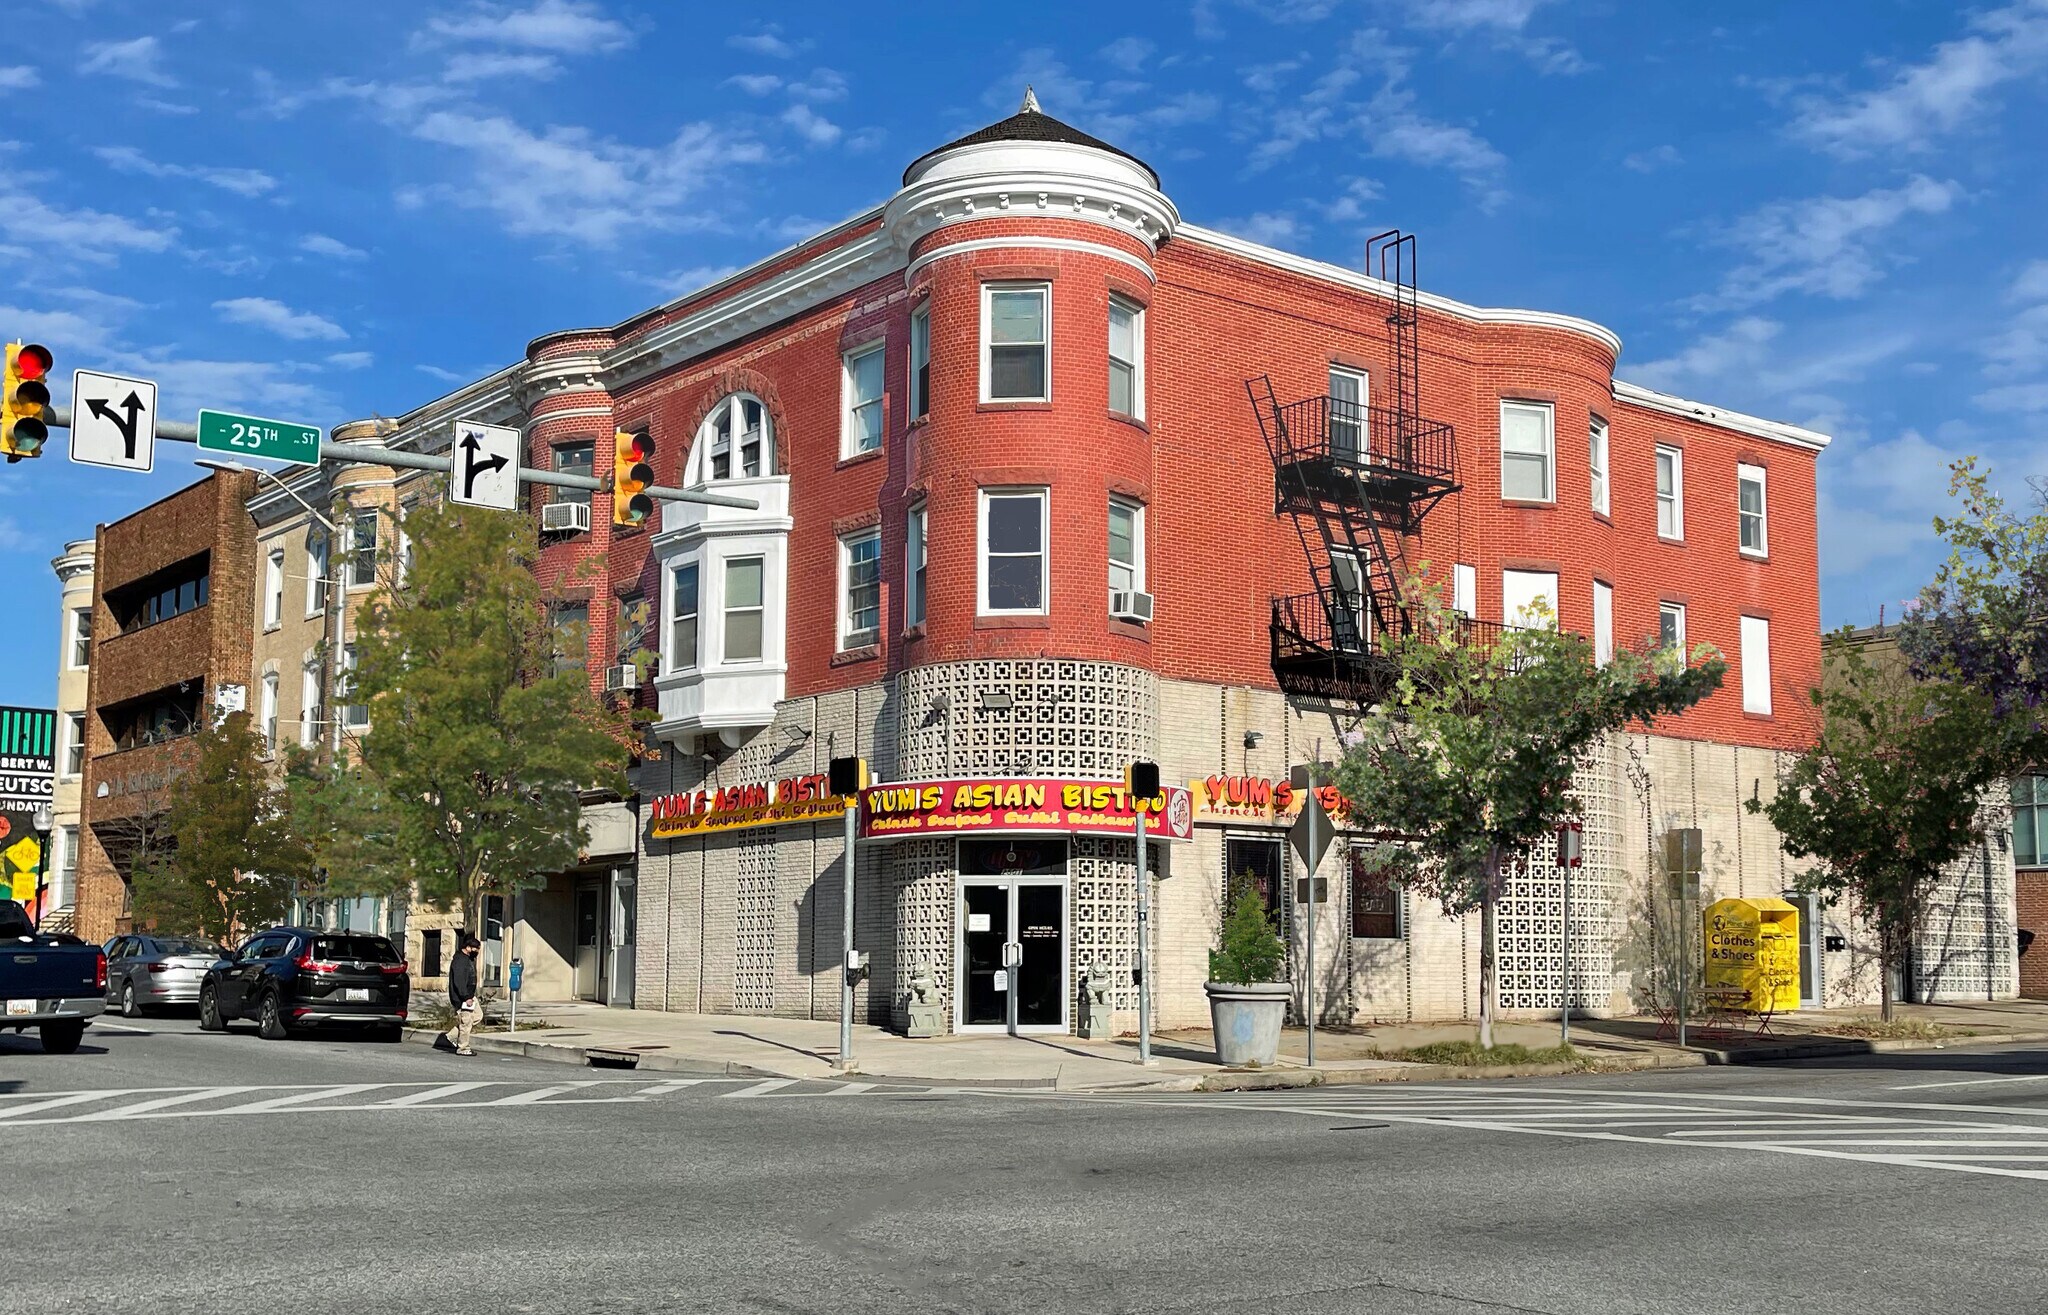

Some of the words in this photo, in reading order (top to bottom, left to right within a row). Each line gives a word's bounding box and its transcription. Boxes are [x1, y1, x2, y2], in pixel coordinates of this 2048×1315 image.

[230, 423, 278, 449] 25TH
[301, 432, 316, 446] ST
[0, 757, 35, 769] BERT
[36, 759, 52, 770] W.
[714, 780, 770, 813] ASIAN
[952, 783, 1046, 811] ASIAN
[1711, 934, 1755, 947] Clothes
[1711, 948, 1720, 960] &
[1721, 948, 1755, 961] Shoes
